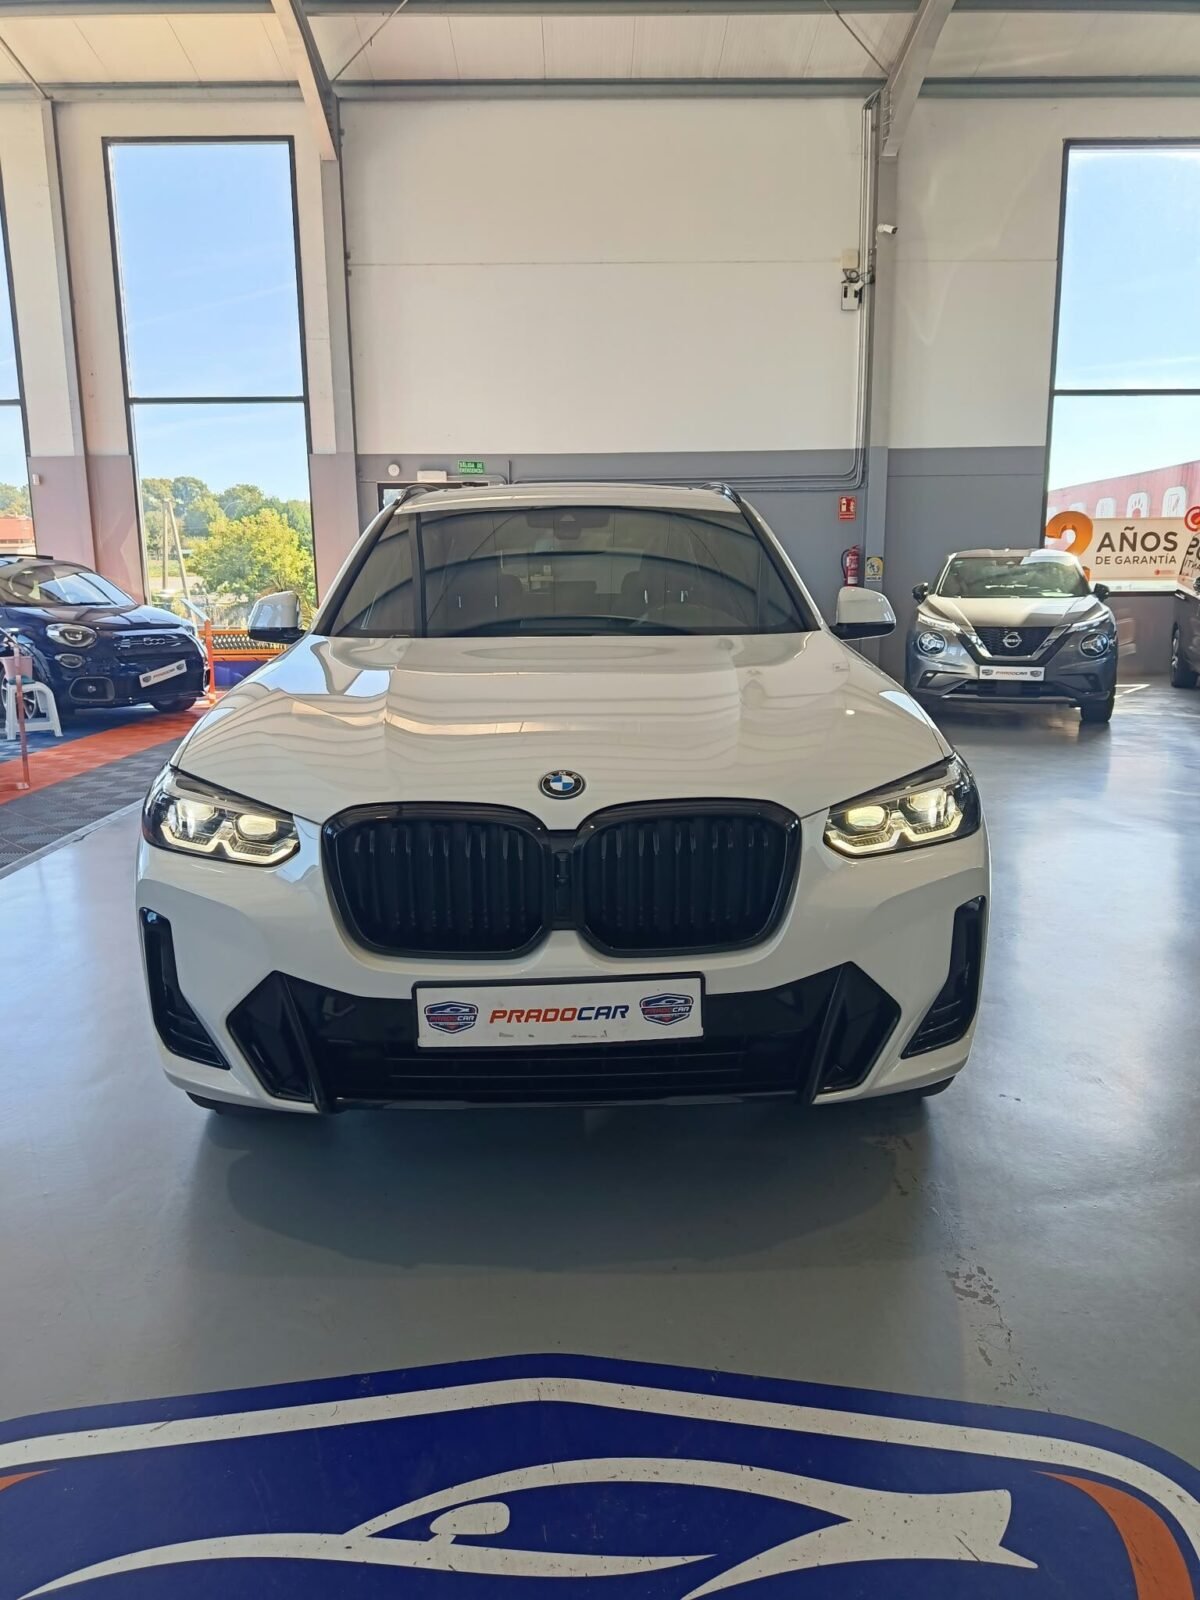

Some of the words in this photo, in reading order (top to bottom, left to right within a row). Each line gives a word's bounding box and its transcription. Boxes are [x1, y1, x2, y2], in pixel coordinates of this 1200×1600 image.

[1096, 526, 1178, 552] AÑOS
[1095, 556, 1111, 565] DE
[1115, 554, 1177, 565] GARANTÍA
[489, 1004, 630, 1024] PRADOCAR
